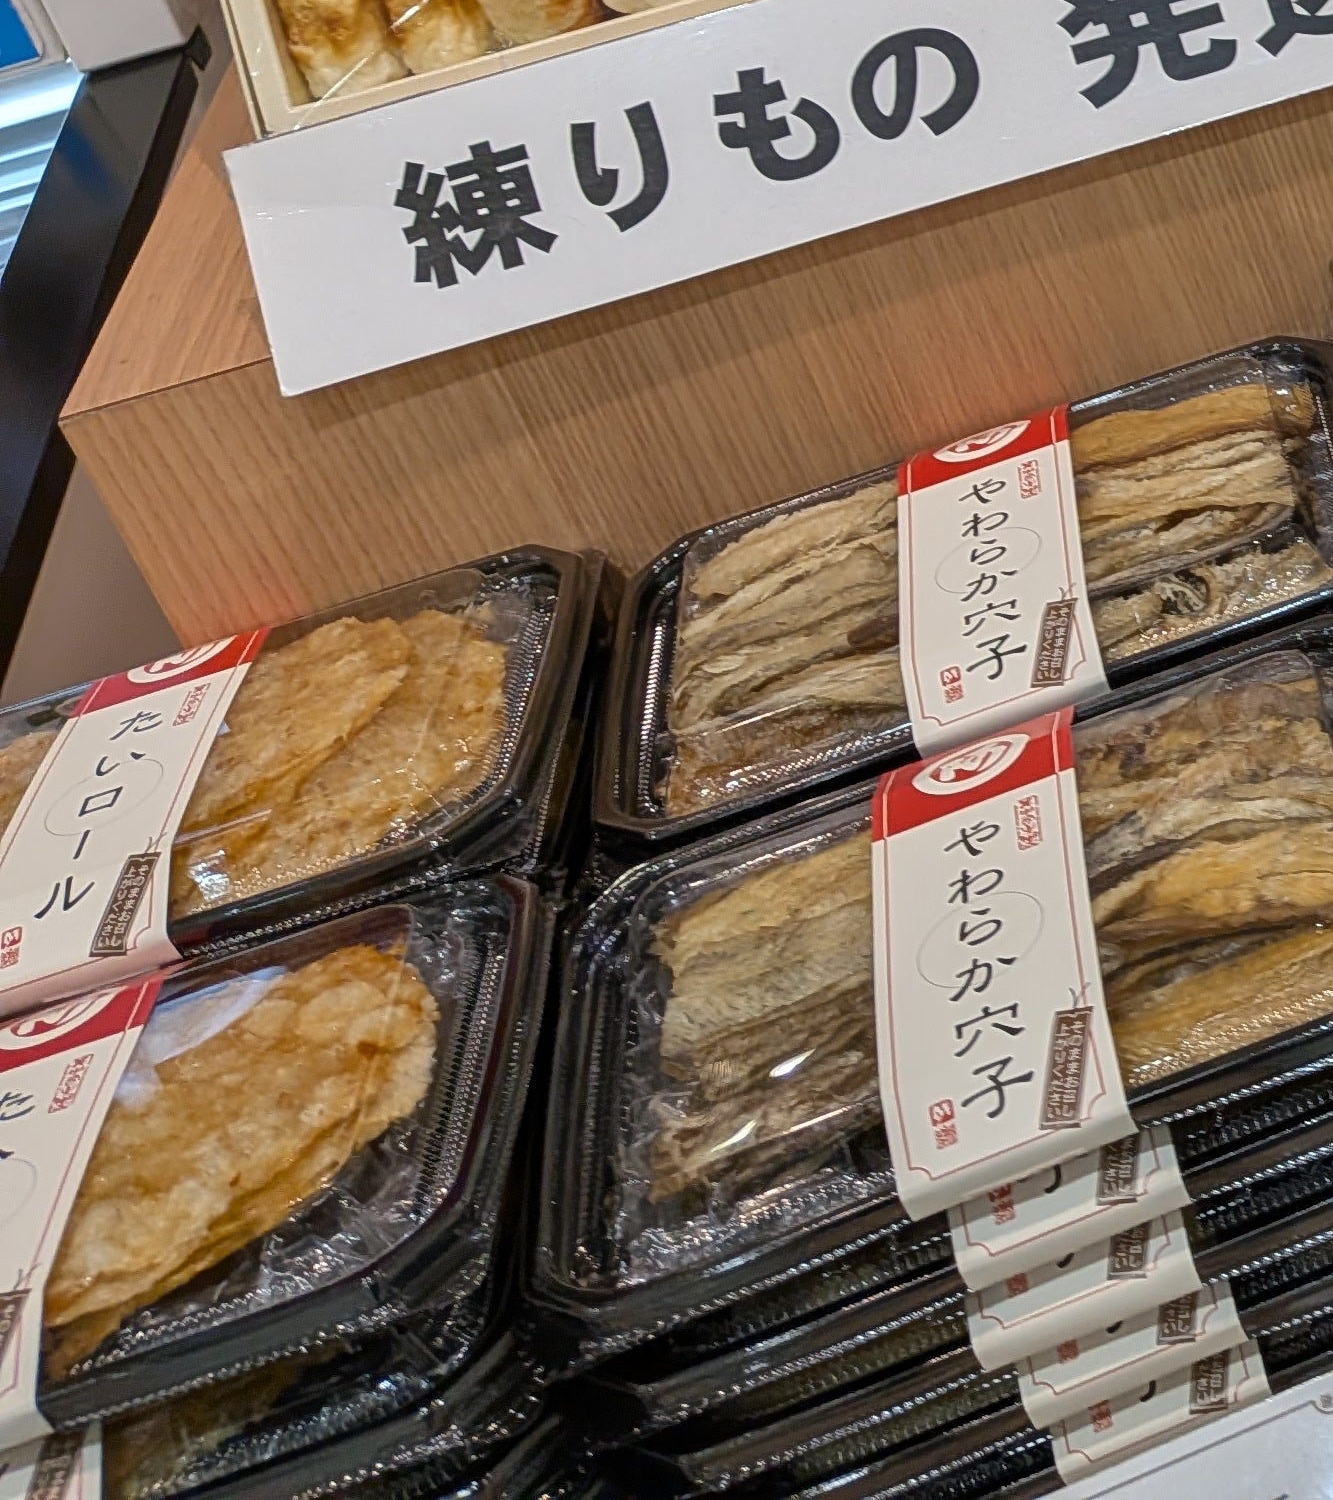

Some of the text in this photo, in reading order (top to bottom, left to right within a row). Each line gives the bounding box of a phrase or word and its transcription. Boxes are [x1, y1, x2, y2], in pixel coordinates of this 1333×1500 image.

[394, 27, 981, 289] 練りもの
[958, 478, 1028, 680] やわらか穴子
[34, 709, 164, 920] たいロール
[943, 820, 1036, 1120] やわらか穴子
